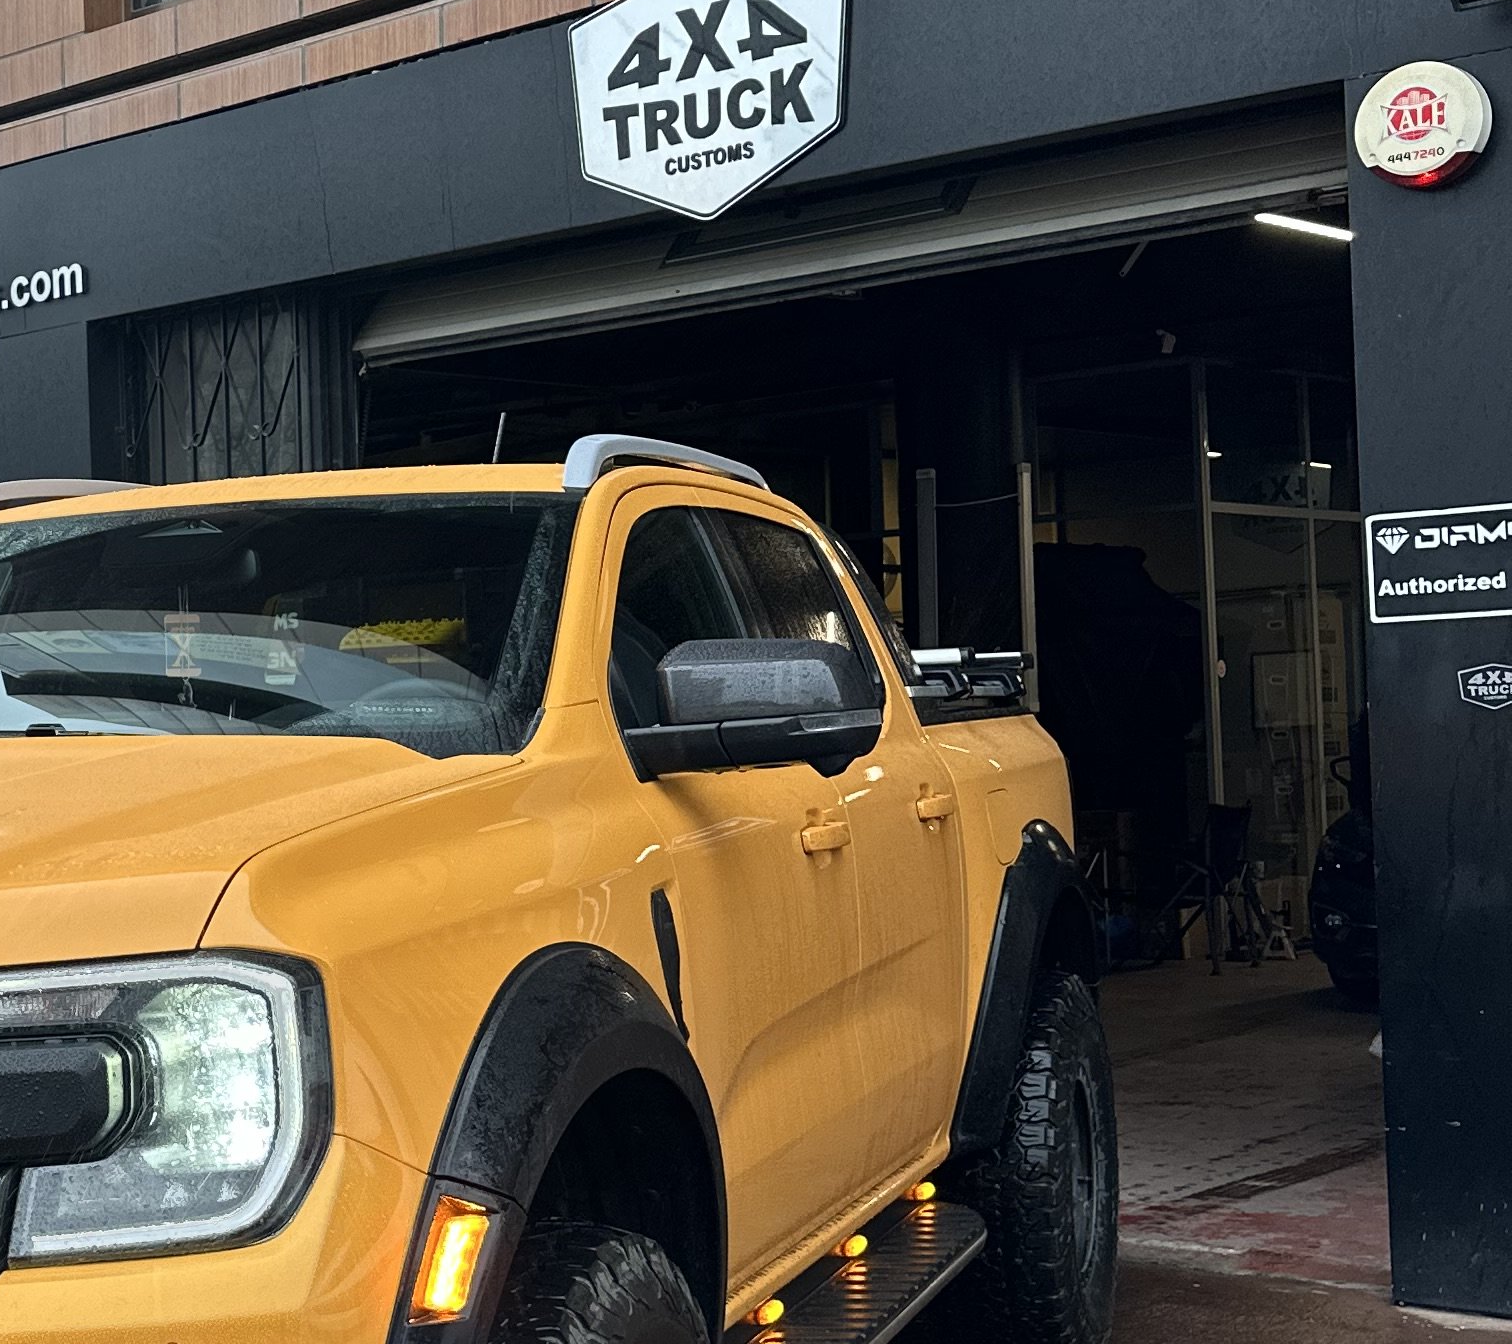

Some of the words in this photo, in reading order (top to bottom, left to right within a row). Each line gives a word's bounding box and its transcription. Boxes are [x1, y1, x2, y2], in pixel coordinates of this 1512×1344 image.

[602, 58, 816, 160] TRUCK
[1382, 98, 1448, 136] KALE
[664, 141, 755, 175] CUSTOMS
[1414, 520, 1512, 549] DIAM
[1378, 571, 1507, 597] Authorized
[1467, 684, 1512, 697] TRUC
